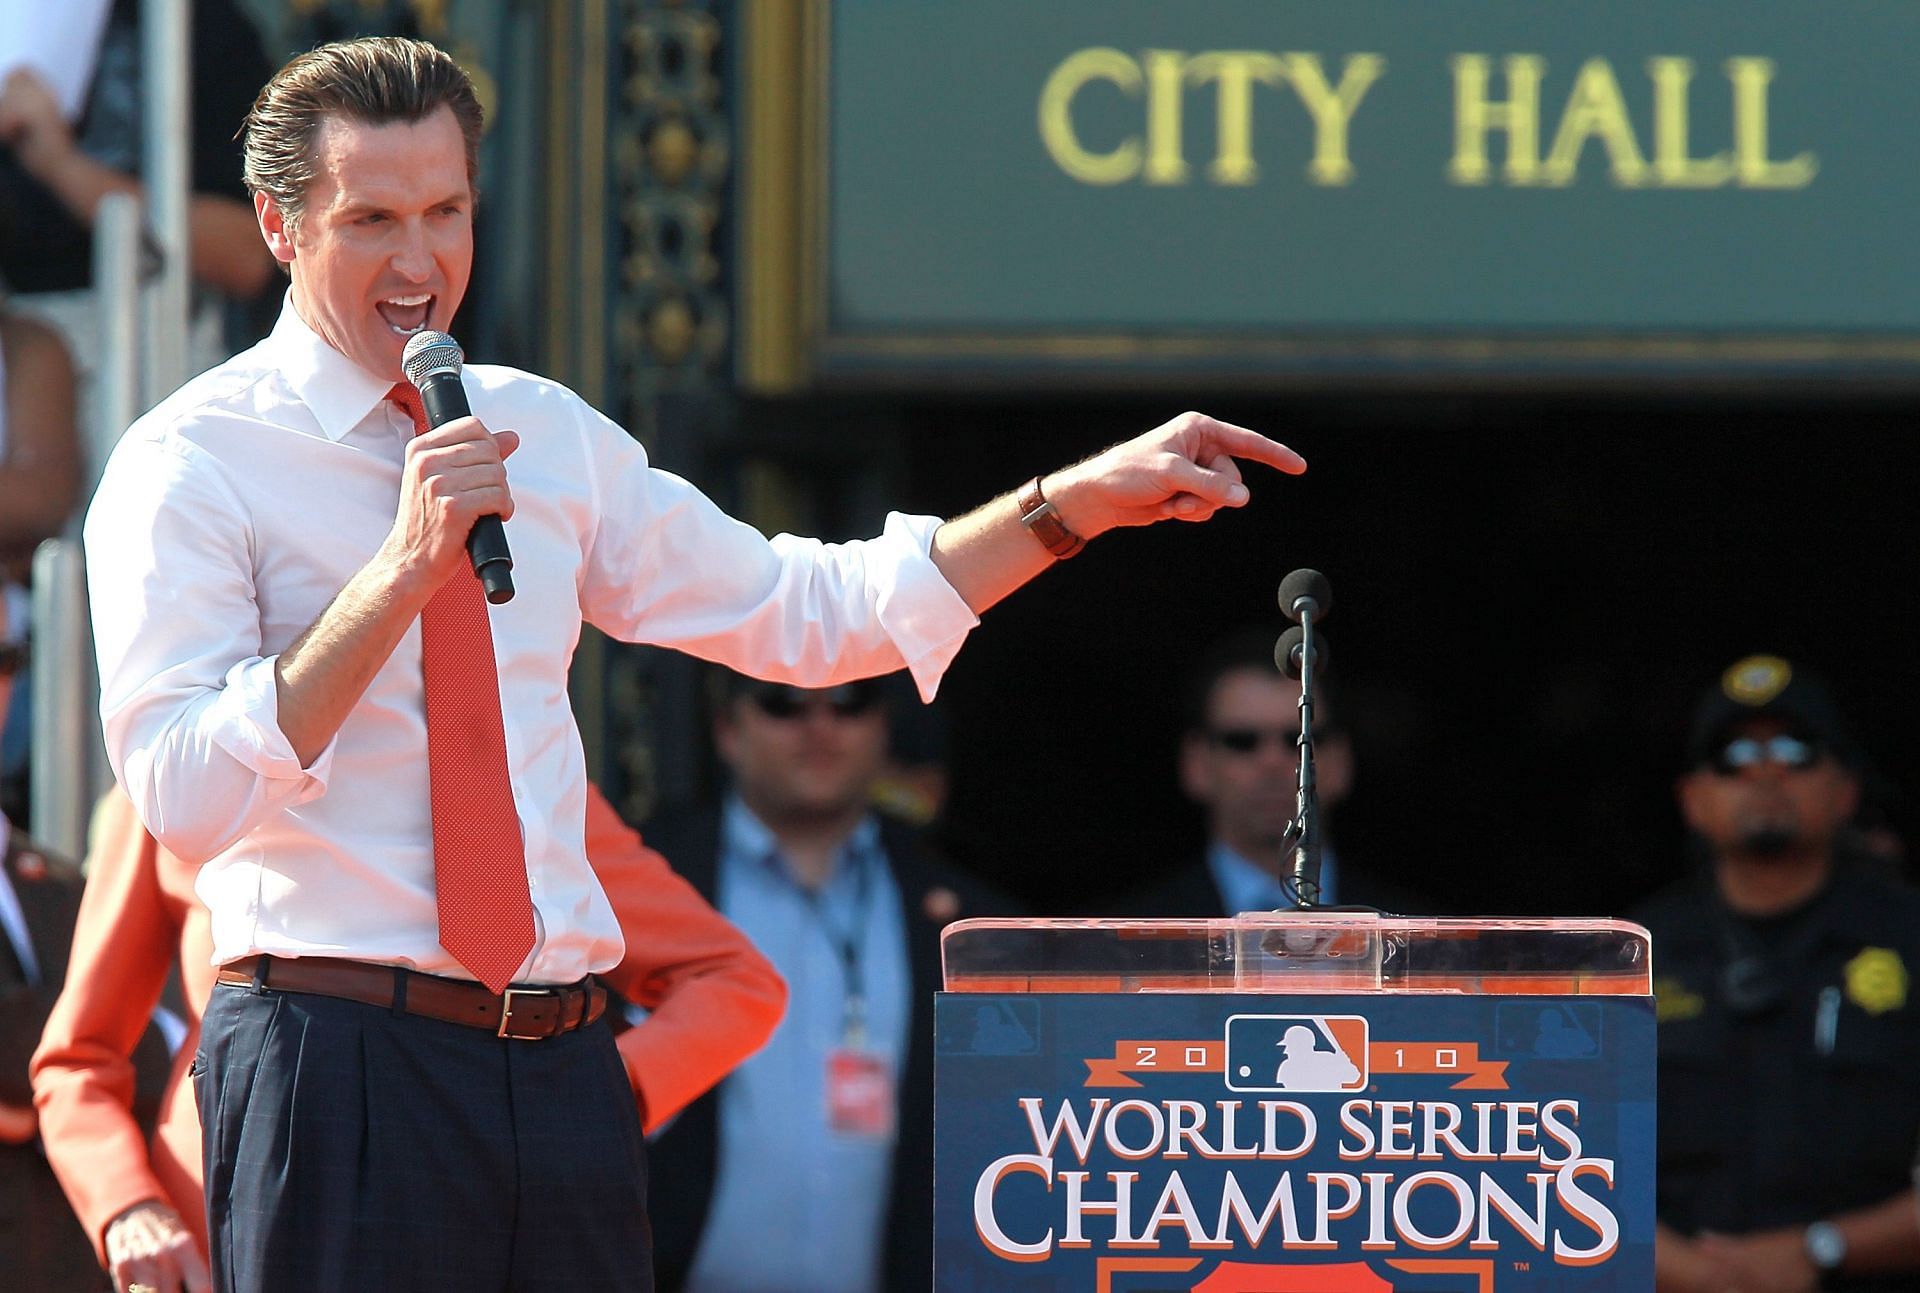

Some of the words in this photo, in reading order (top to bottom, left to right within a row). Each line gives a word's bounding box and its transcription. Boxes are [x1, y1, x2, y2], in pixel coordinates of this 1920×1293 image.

[1037, 46, 1387, 187] CITY
[1449, 53, 1819, 189] HALL
[1019, 1097, 1318, 1165] WORLD
[1338, 1098, 1582, 1168] SERIES
[973, 1153, 1620, 1266] CHAMPIONS
